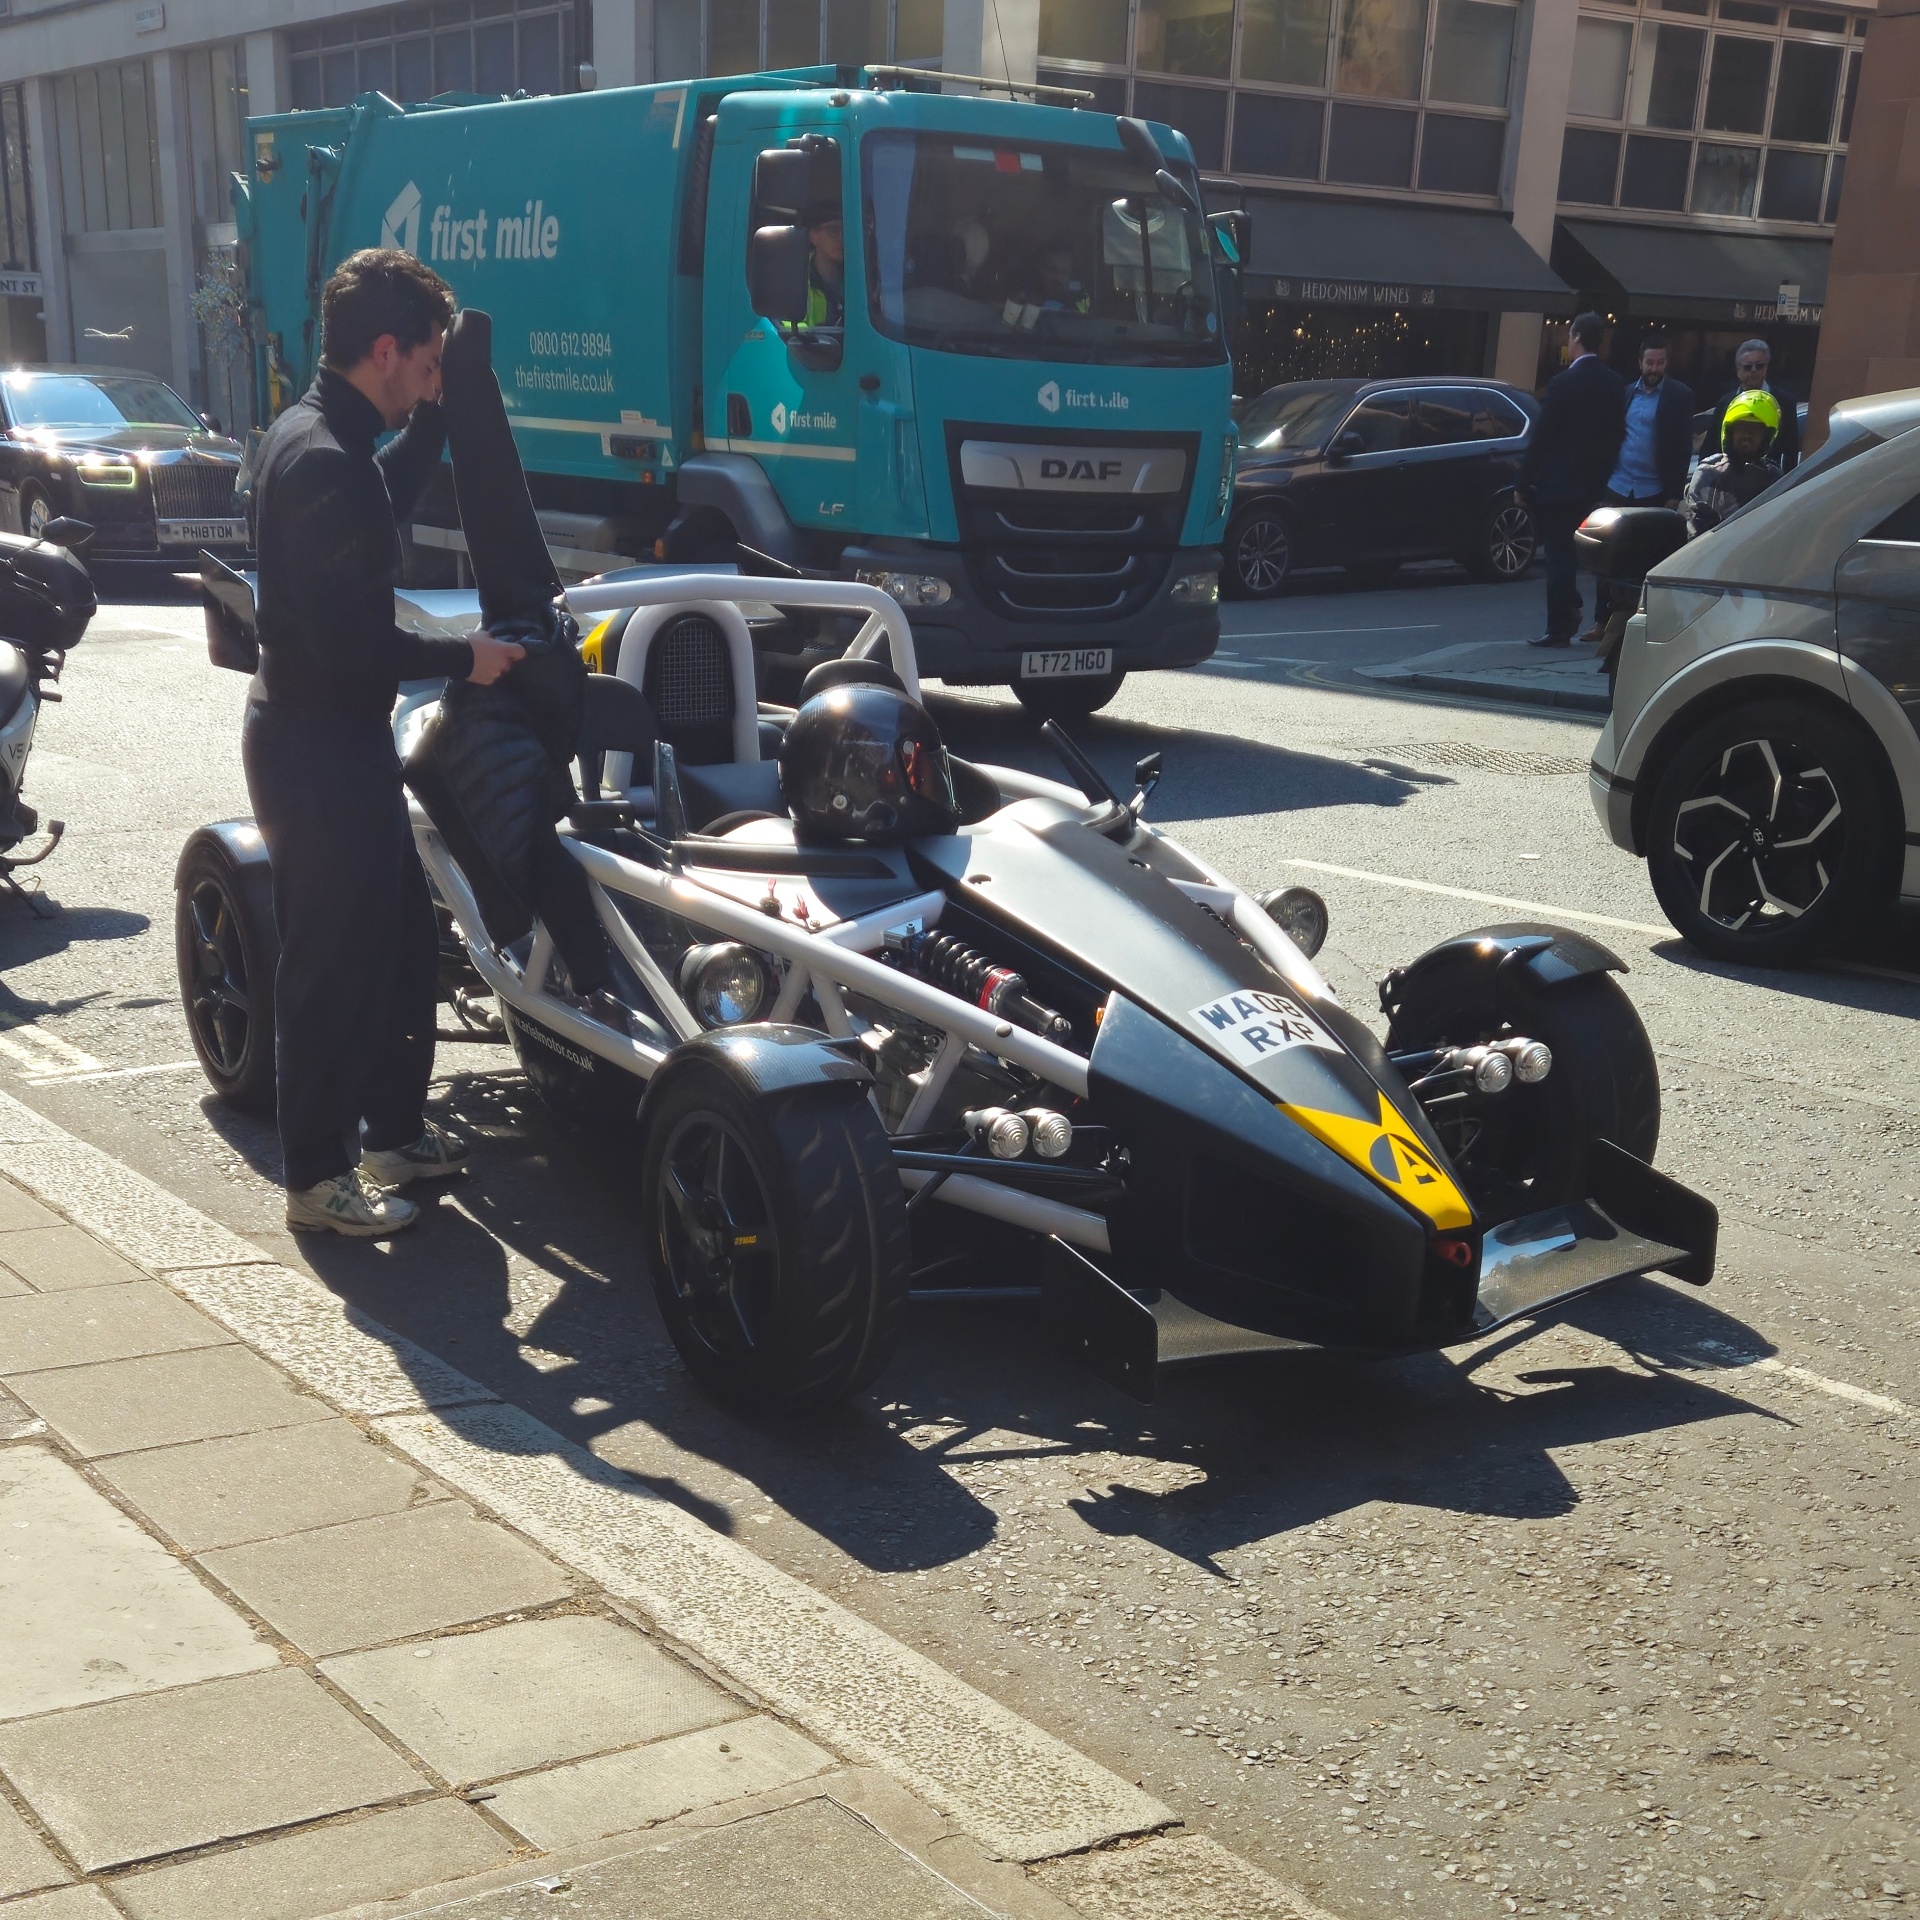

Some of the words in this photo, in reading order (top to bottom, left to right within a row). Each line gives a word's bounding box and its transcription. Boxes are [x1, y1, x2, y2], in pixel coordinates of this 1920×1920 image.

[430, 204, 488, 261] first
[495, 199, 559, 260] mile
[22, 281, 37, 293] ST
[1302, 281, 1368, 301] HEDONISM
[1373, 285, 1410, 304] WINES
[529, 331, 559, 356] 0800
[560, 332, 580, 356] 612
[581, 332, 612, 357] 9894
[514, 365, 614, 393] thefirstmile.co.uk
[789, 410, 811, 427] first
[814, 411, 837, 428] mile
[1040, 458, 1122, 481] DAF
[819, 501, 845, 516] LF
[1028, 652, 1071, 674] LT72
[1074, 650, 1106, 671] HGO
[1198, 993, 1305, 1031] WA08
[1240, 1018, 1315, 1054] RXP
